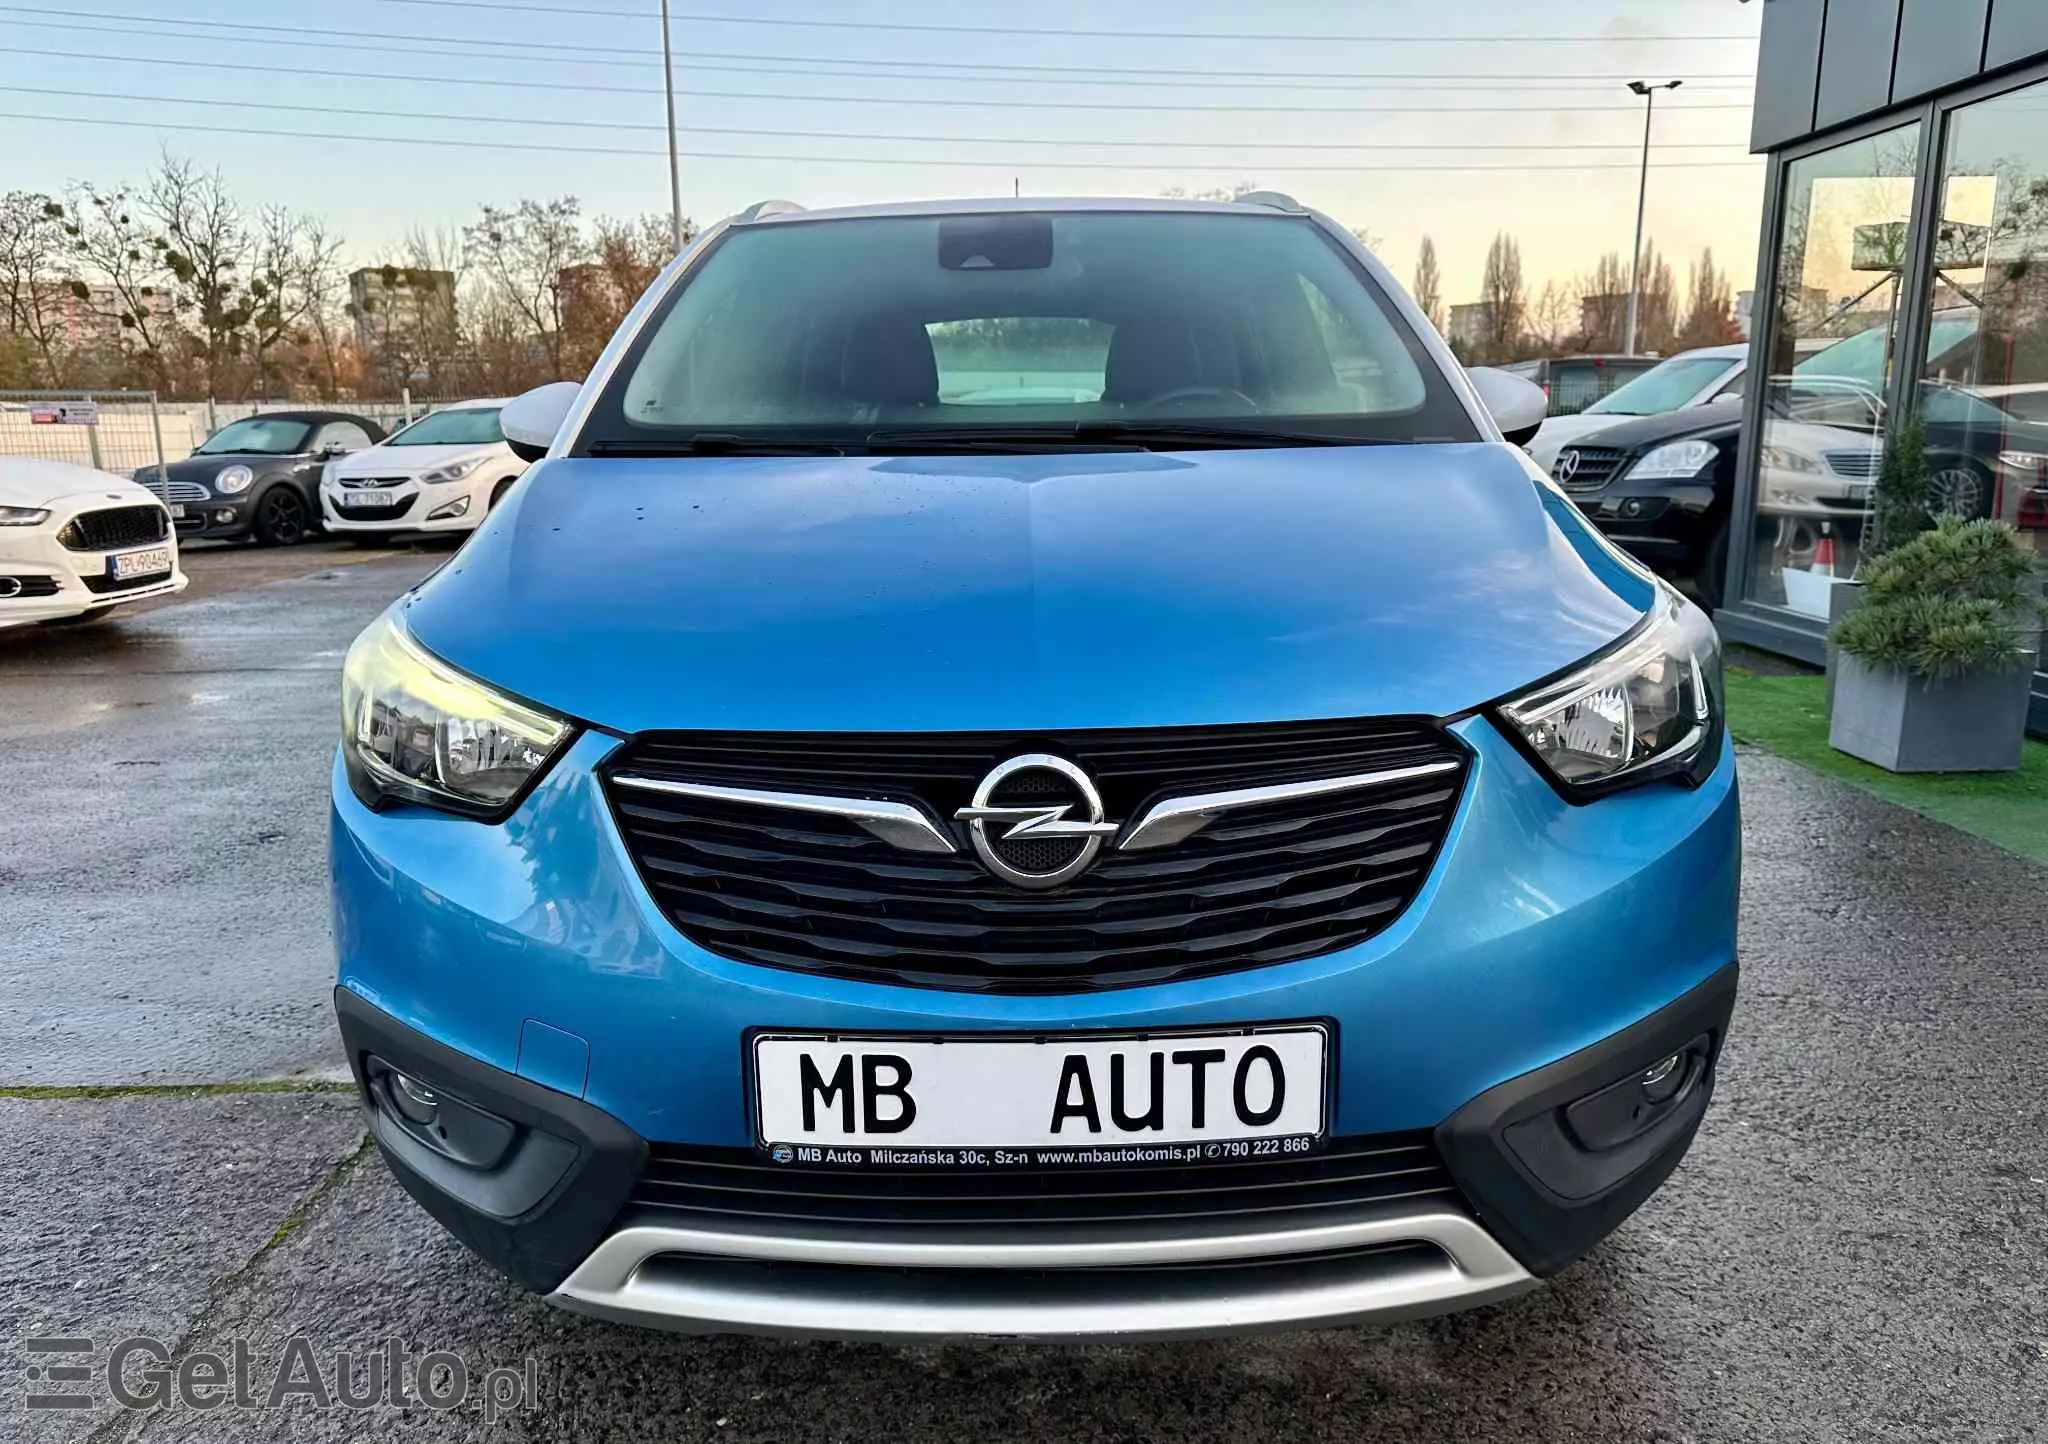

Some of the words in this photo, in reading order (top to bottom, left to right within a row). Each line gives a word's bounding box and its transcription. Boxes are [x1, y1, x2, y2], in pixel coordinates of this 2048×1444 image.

[800, 1053, 917, 1133] MB
[1050, 1044, 1286, 1133] AUTO
[798, 1147, 821, 1162] MB
[826, 1149, 862, 1163] Auto
[871, 1149, 954, 1164] Milczańska
[959, 1150, 990, 1166] 30c,
[994, 1150, 1028, 1164] Sz-n
[1037, 1144, 1200, 1163] www.mbautokomis.pl
[1223, 1142, 1249, 1156] 790
[1253, 1140, 1279, 1155] 222
[1283, 1137, 1310, 1152] 866
